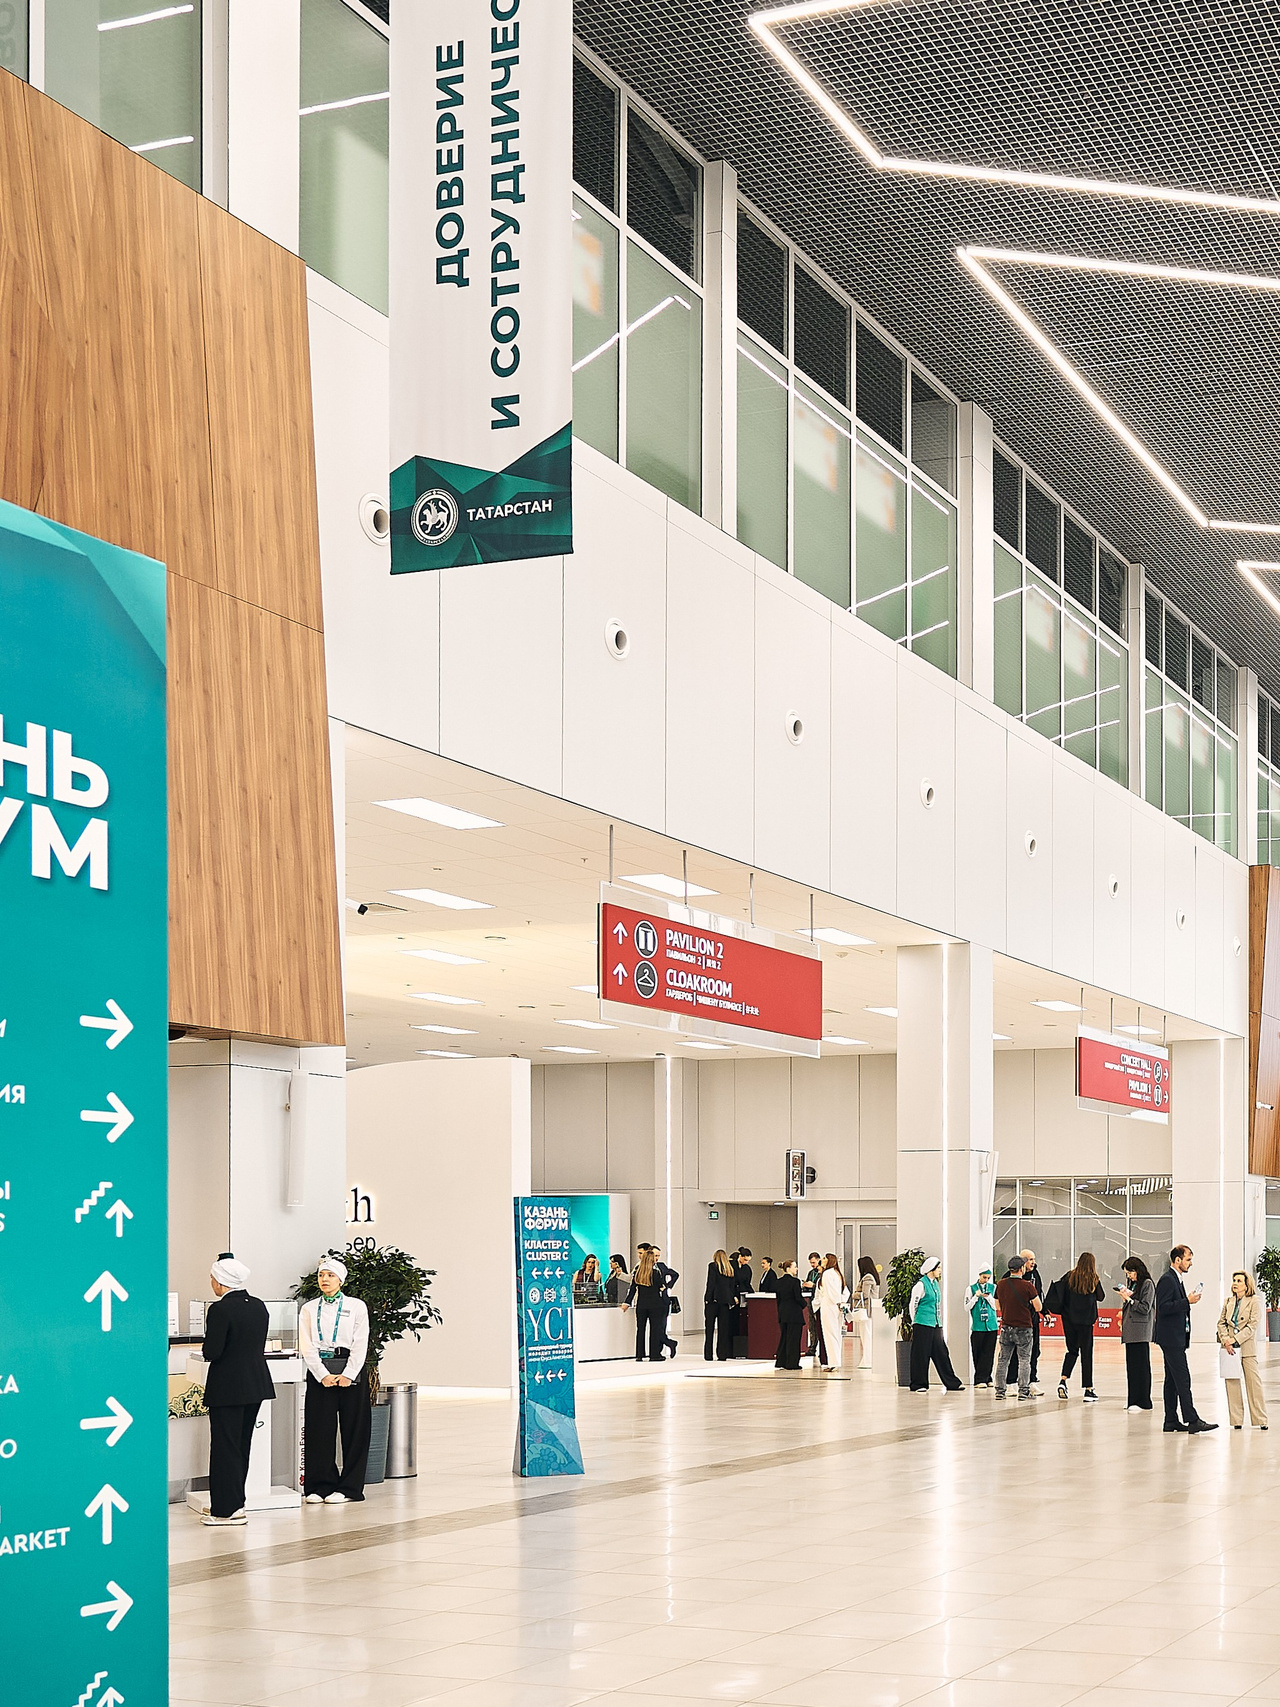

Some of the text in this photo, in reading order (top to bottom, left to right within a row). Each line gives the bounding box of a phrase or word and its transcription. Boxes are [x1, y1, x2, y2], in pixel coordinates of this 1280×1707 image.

[436, 40, 470, 288] ДОВЕРИЕ
[491, 0, 525, 430] И СОТРУДНИЧЕС
[467, 499, 553, 521] ТАТАРСТАН
[665, 929, 724, 959] PAVILION 2
[697, 956, 702, 966] 2
[666, 968, 733, 998] CLOAKROOM
[524, 1206, 568, 1218] КАЗАНЬ
[524, 1218, 569, 1230] ФОРУМ
[524, 1240, 562, 1250] КЛАСТЕР
[525, 1251, 562, 1261] CLUSTER
[526, 1306, 573, 1342] YCI
